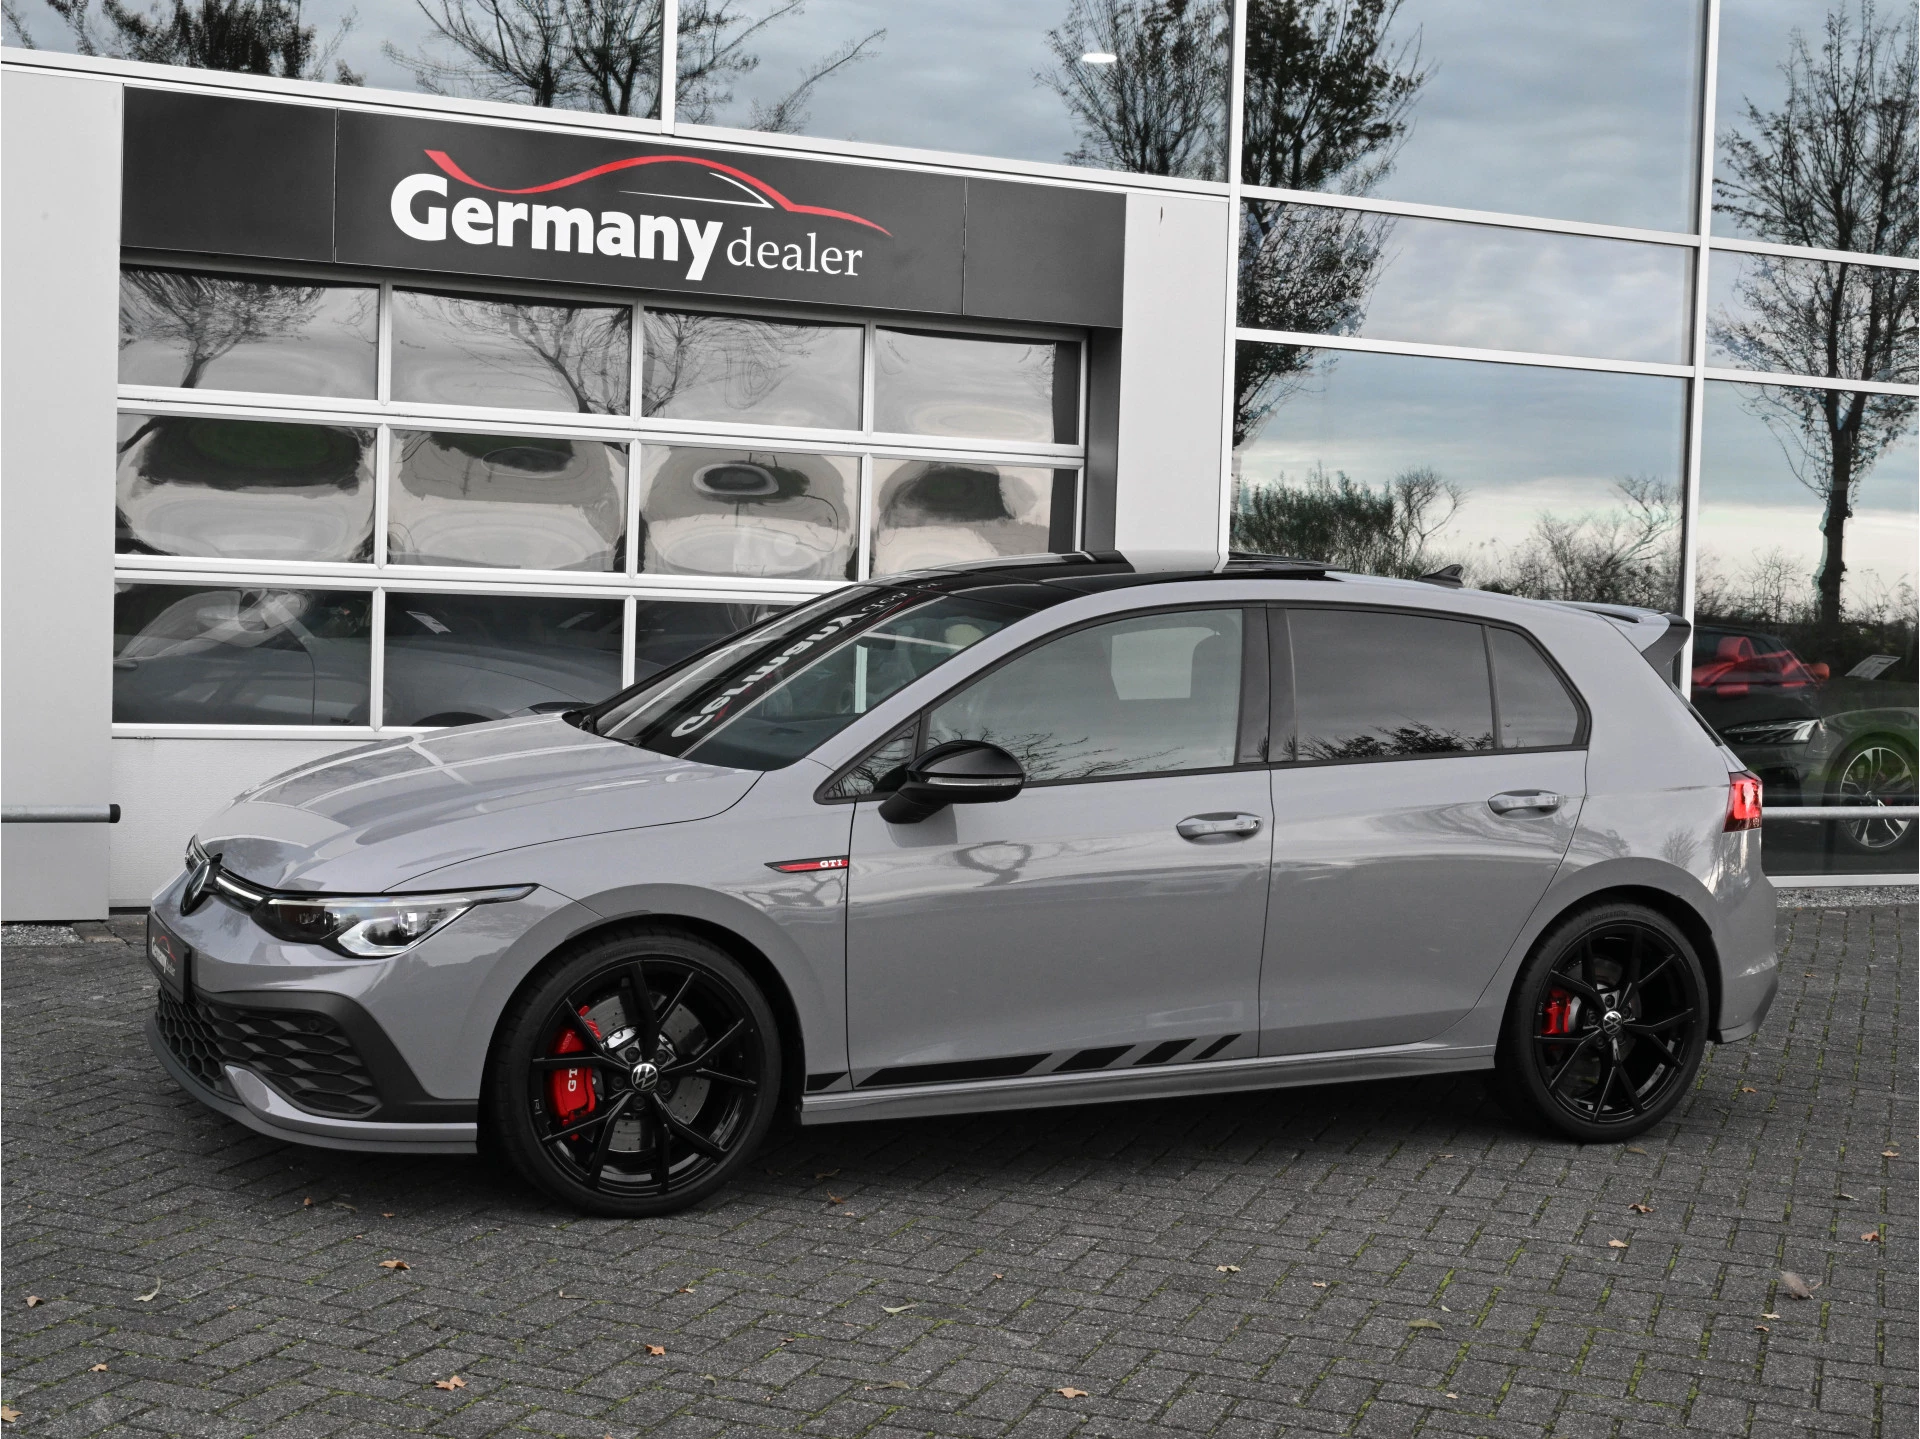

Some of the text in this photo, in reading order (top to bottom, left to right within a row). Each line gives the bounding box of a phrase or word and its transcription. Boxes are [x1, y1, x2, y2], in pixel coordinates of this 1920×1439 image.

[390, 173, 864, 281] Germany dealer
[819, 859, 843, 868] GTI
[567, 1068, 578, 1092] GT
